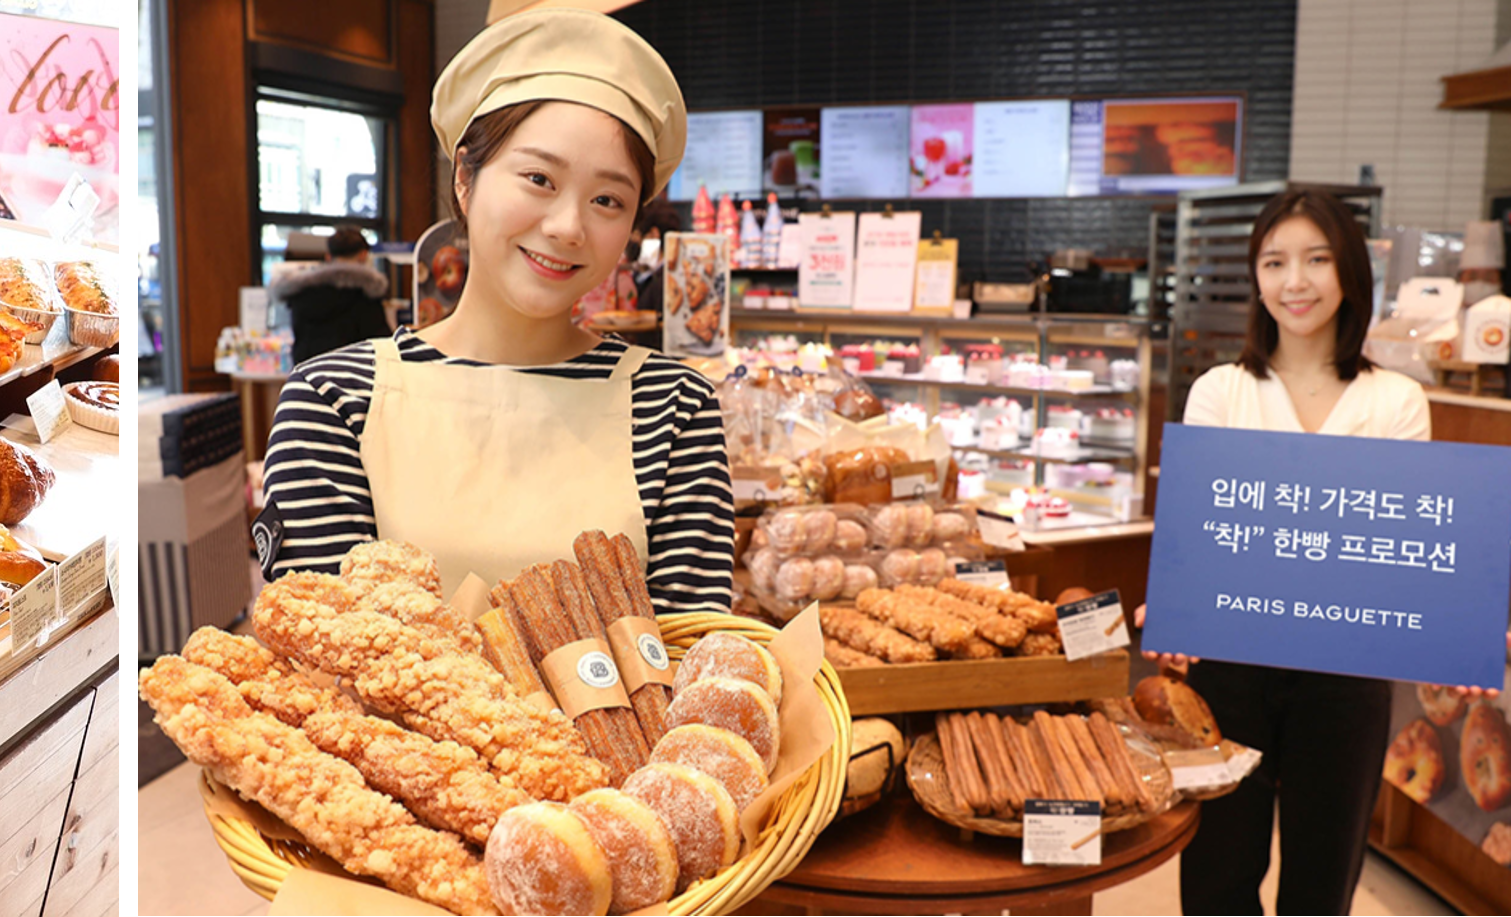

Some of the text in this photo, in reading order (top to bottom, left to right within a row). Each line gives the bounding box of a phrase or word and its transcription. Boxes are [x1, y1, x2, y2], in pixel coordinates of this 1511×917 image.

[1211, 478, 1454, 526] 입에 착! 가격도 착!
[1273, 528, 1331, 562] 한빵
[1338, 534, 1456, 573] 프로모션
[1216, 594, 1423, 630] PARIS BAGUETTE
